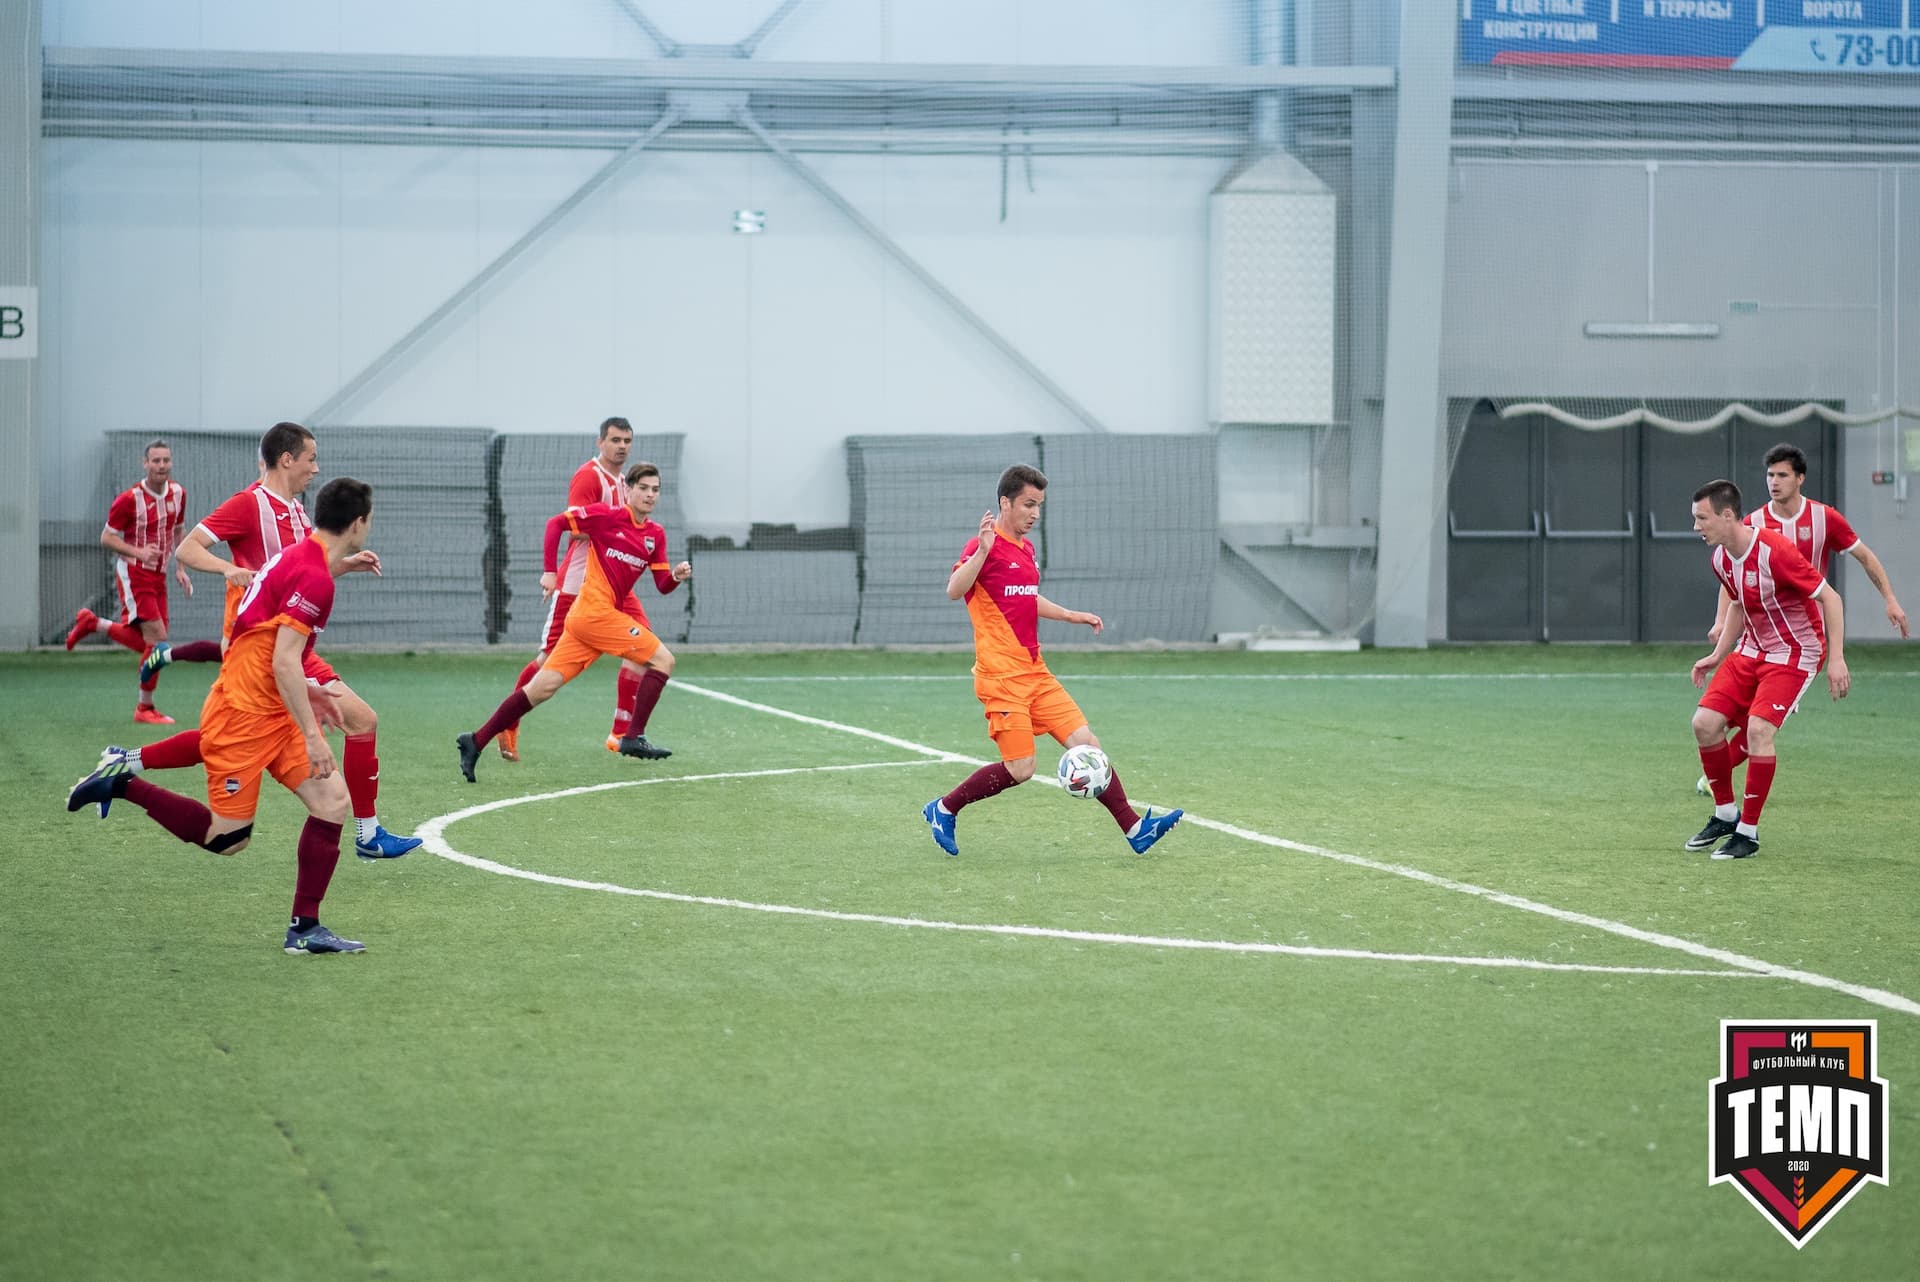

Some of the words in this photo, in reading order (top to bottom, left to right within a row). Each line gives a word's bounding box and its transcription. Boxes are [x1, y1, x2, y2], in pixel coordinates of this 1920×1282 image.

[1660, 0, 1732, 20] ТЕРРАСЫ
[1803, 0, 1863, 19] ВОРОТА
[1482, 19, 1598, 41] КОНСТРУКЦИИ
